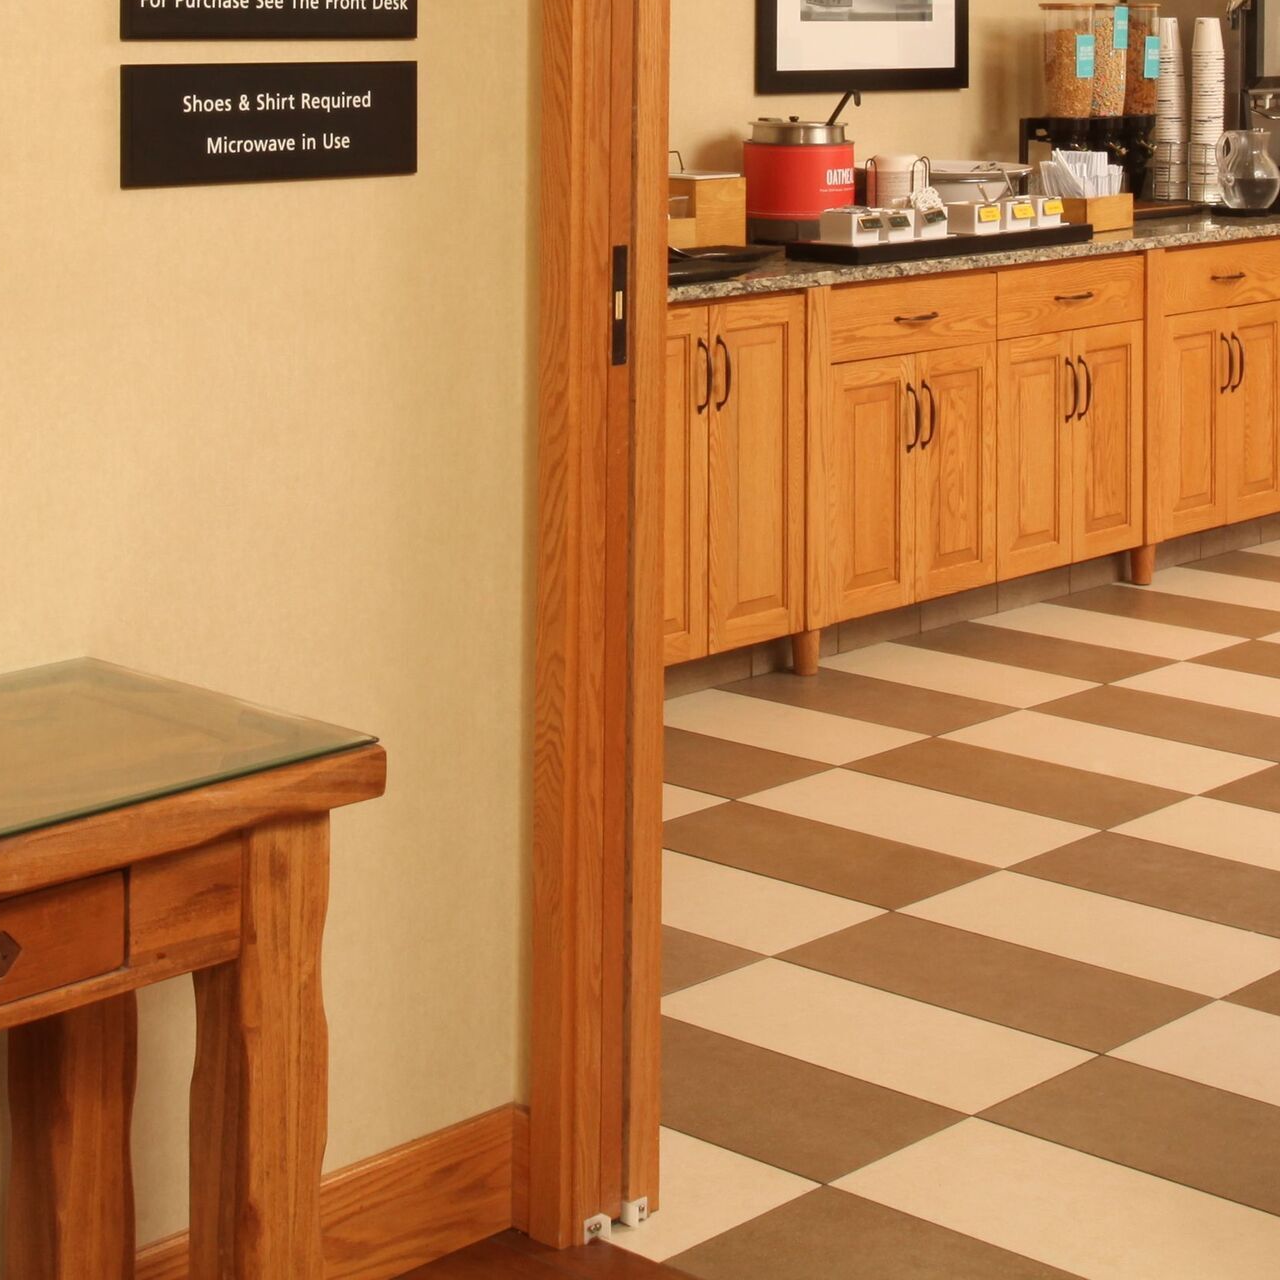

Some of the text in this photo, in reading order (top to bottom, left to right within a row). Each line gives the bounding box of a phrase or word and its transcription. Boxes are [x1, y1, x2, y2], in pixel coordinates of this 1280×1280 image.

[183, 90, 371, 113] Shoes & Shirt Required
[207, 132, 351, 154] Microwave in Use
